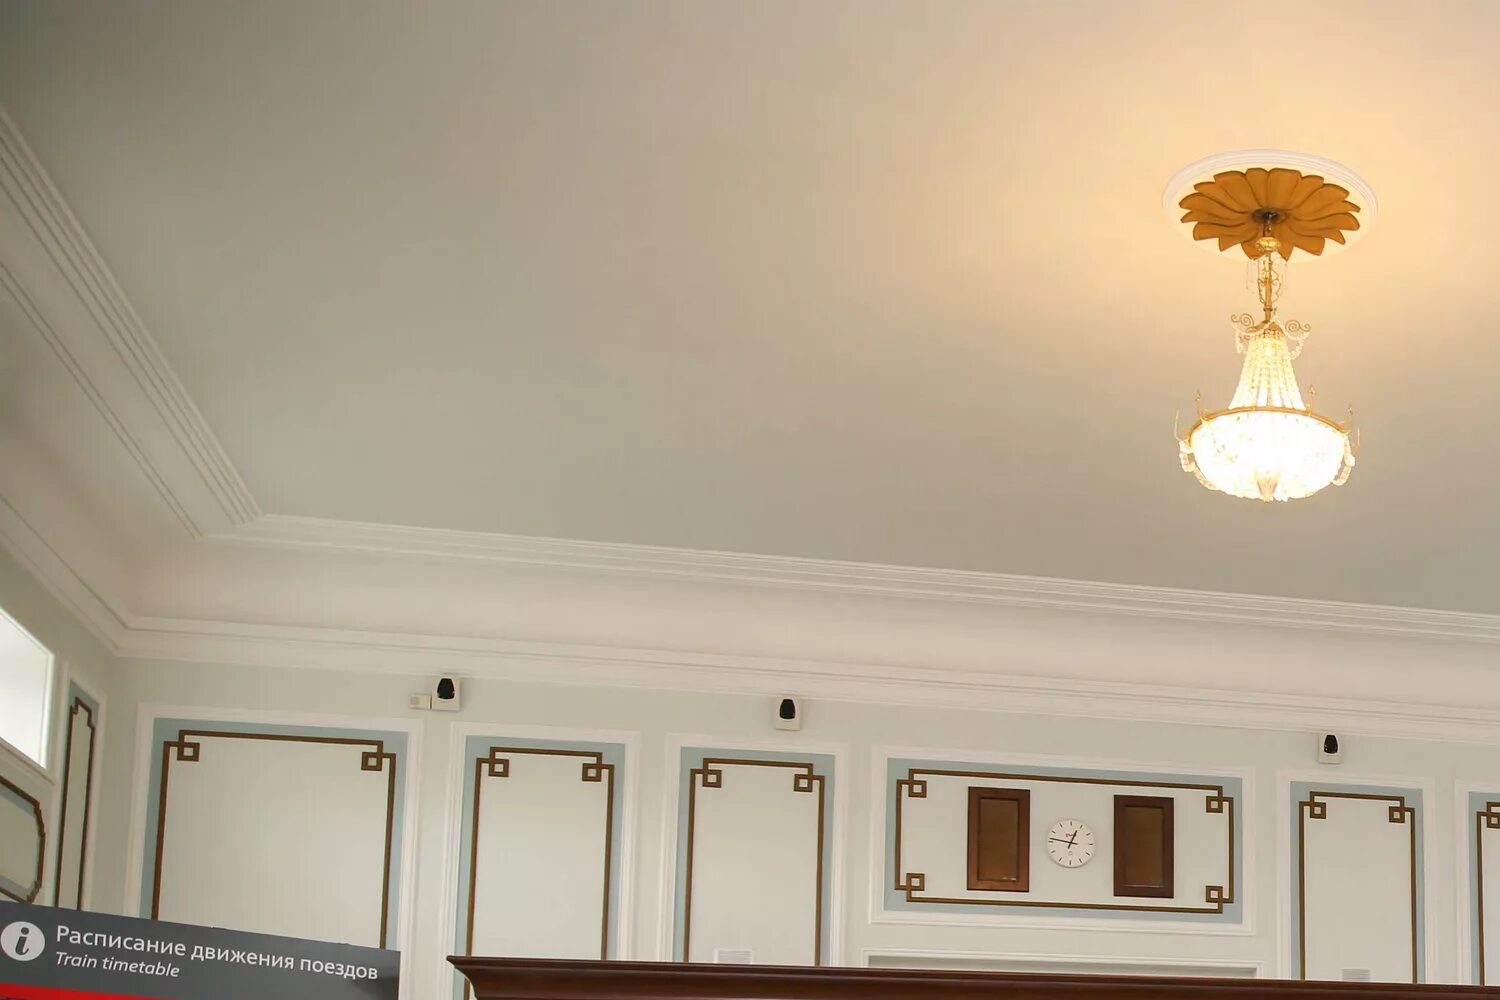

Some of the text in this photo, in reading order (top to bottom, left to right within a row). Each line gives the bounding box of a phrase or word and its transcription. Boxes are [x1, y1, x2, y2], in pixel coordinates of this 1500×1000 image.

[55, 924, 379, 981] Расписание движения поездов
[55, 951, 180, 978] Train timetable
